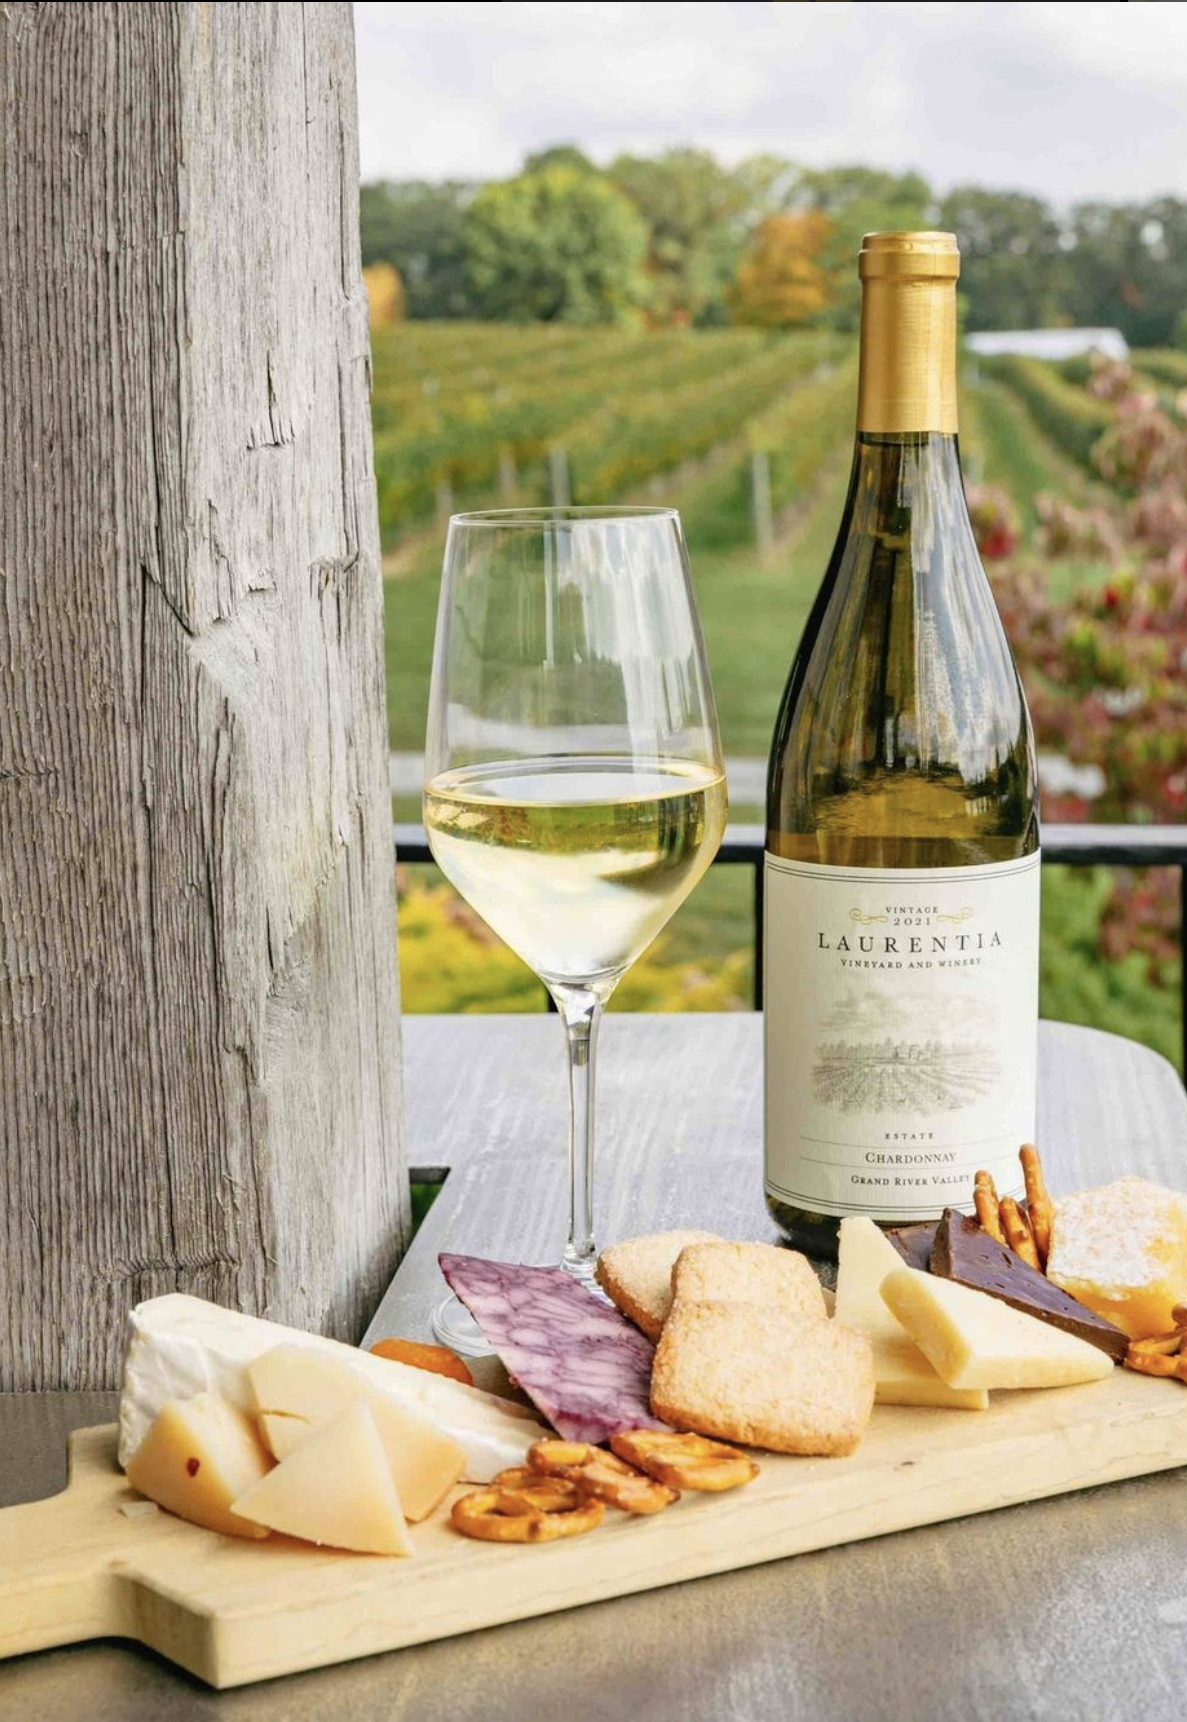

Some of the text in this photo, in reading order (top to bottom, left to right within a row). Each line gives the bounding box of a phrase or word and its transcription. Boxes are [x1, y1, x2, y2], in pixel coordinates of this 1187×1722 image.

[885, 906, 939, 914] VINTAGE
[893, 917, 931, 926] 2021
[817, 931, 1003, 953] LAURENTIA
[840, 957, 983, 969] VINEYARD AND WINERY
[885, 1132, 935, 1140] ESTATE
